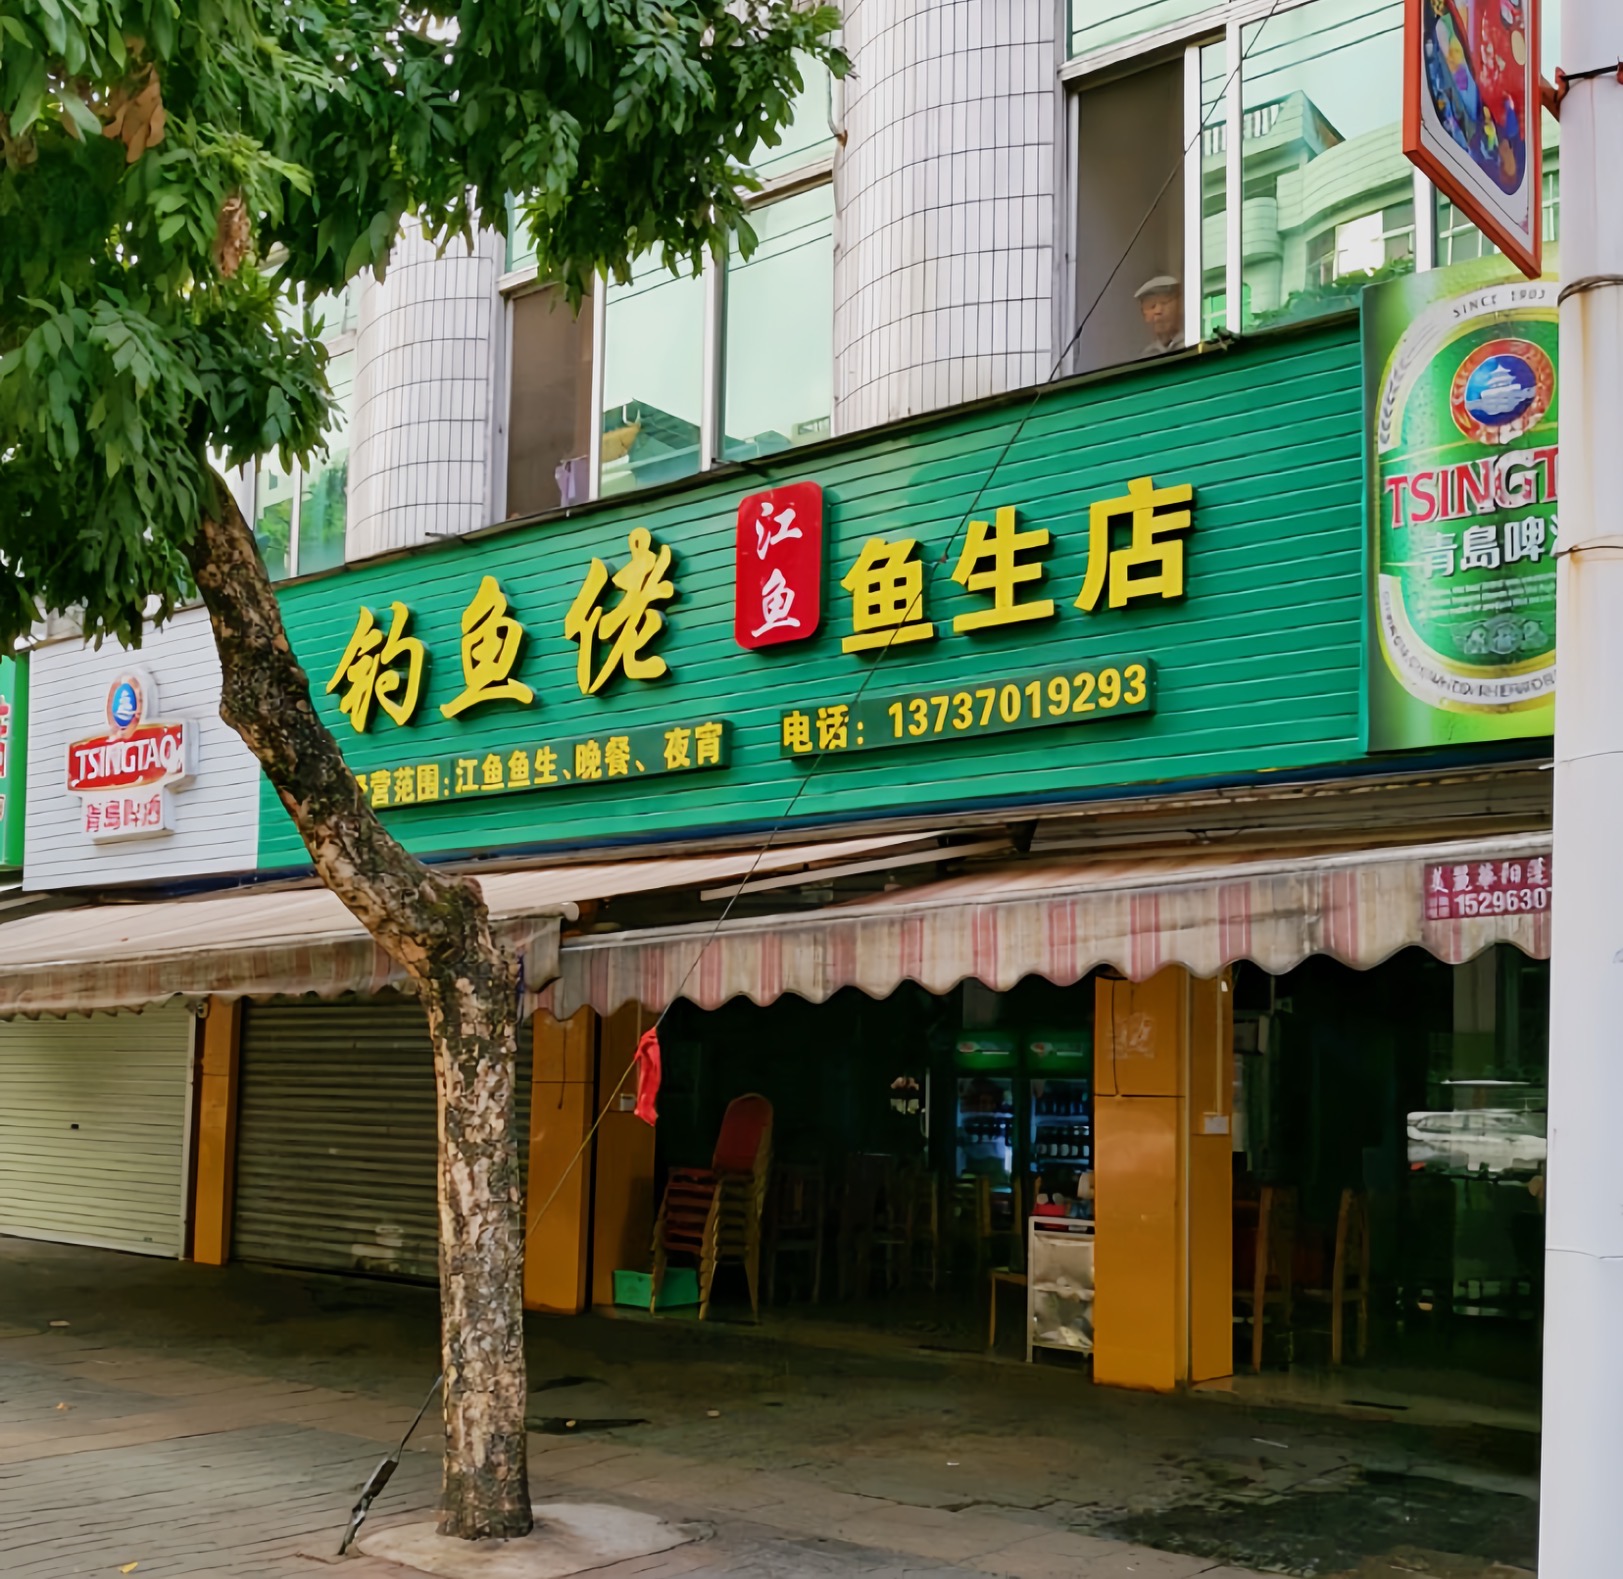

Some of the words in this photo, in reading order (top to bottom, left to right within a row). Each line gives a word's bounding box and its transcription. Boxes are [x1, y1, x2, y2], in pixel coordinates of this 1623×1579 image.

[326, 527, 674, 733] 钓鱼佬
[751, 502, 803, 637] 江鱼
[841, 476, 1193, 654] 鱼生店
[888, 664, 1147, 739] 13737019293
[1454, 887, 1552, 916] 1529630
